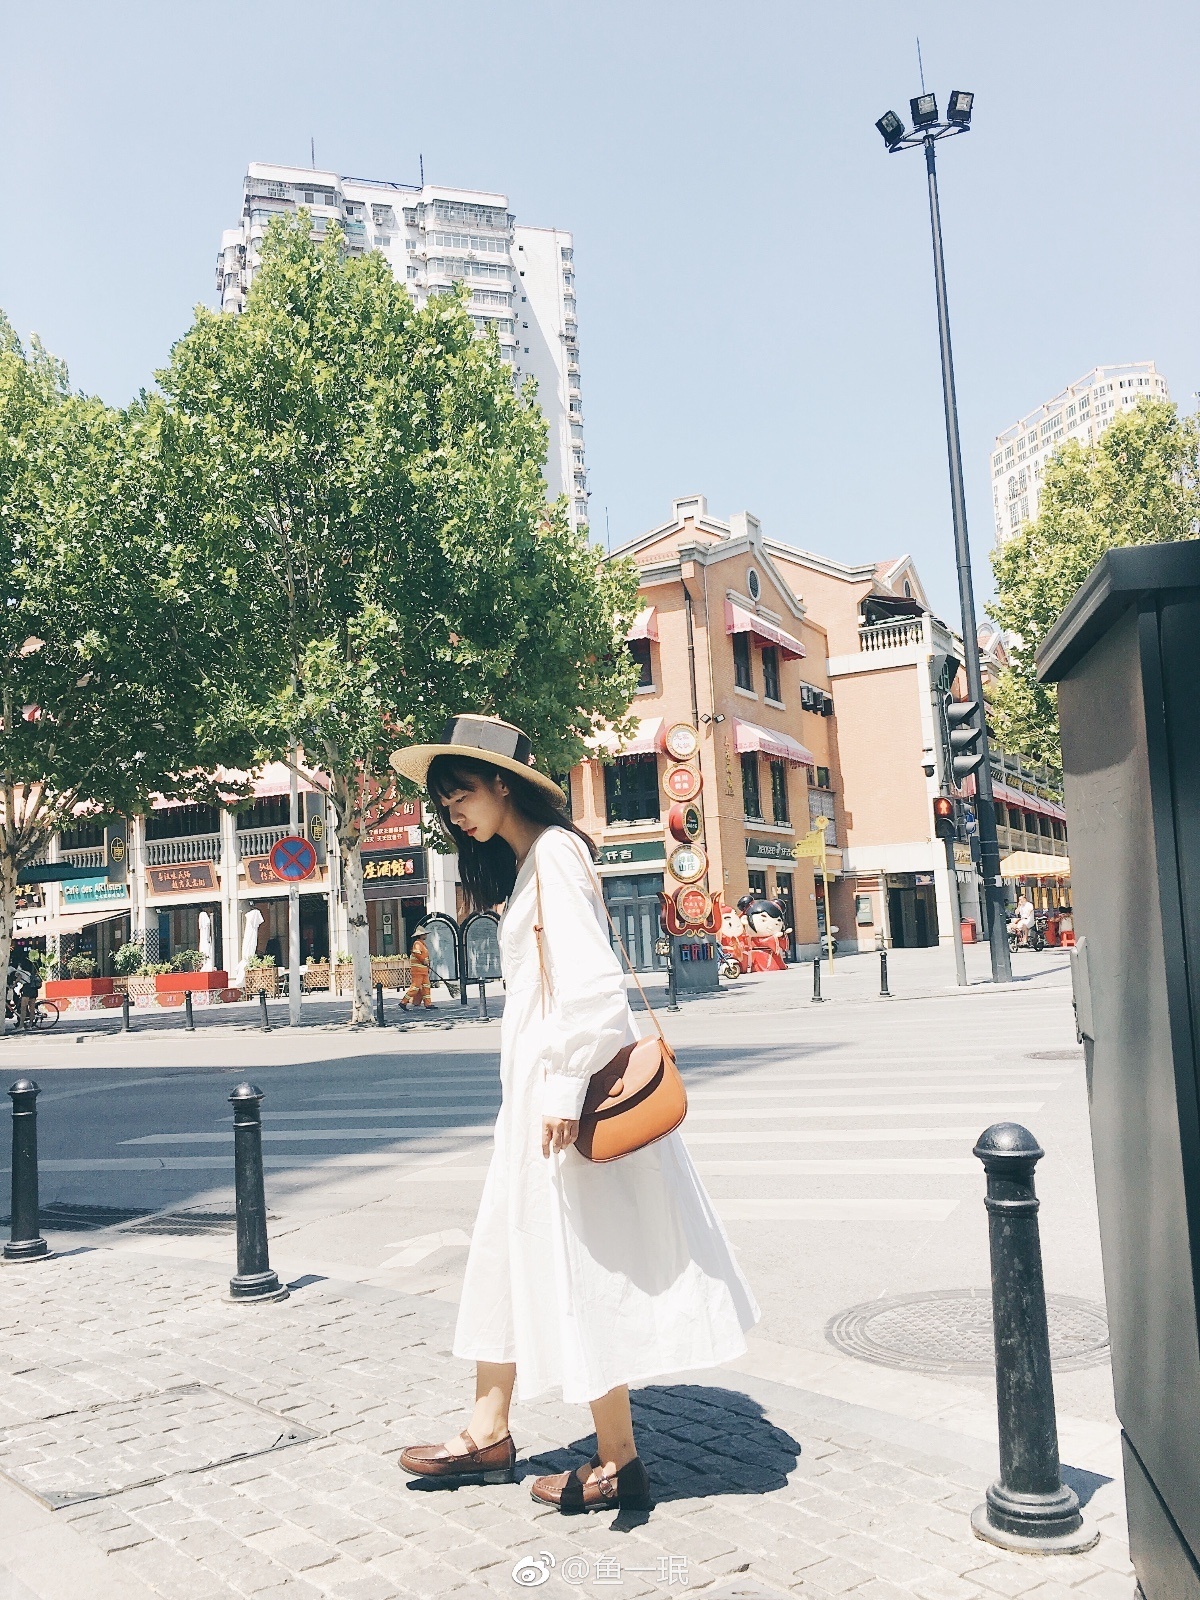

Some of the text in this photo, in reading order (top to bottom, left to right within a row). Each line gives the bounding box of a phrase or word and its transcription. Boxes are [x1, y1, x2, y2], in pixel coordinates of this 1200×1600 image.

[605, 850, 632, 860] 仔吉
[364, 859, 405, 879] 座酒馆
